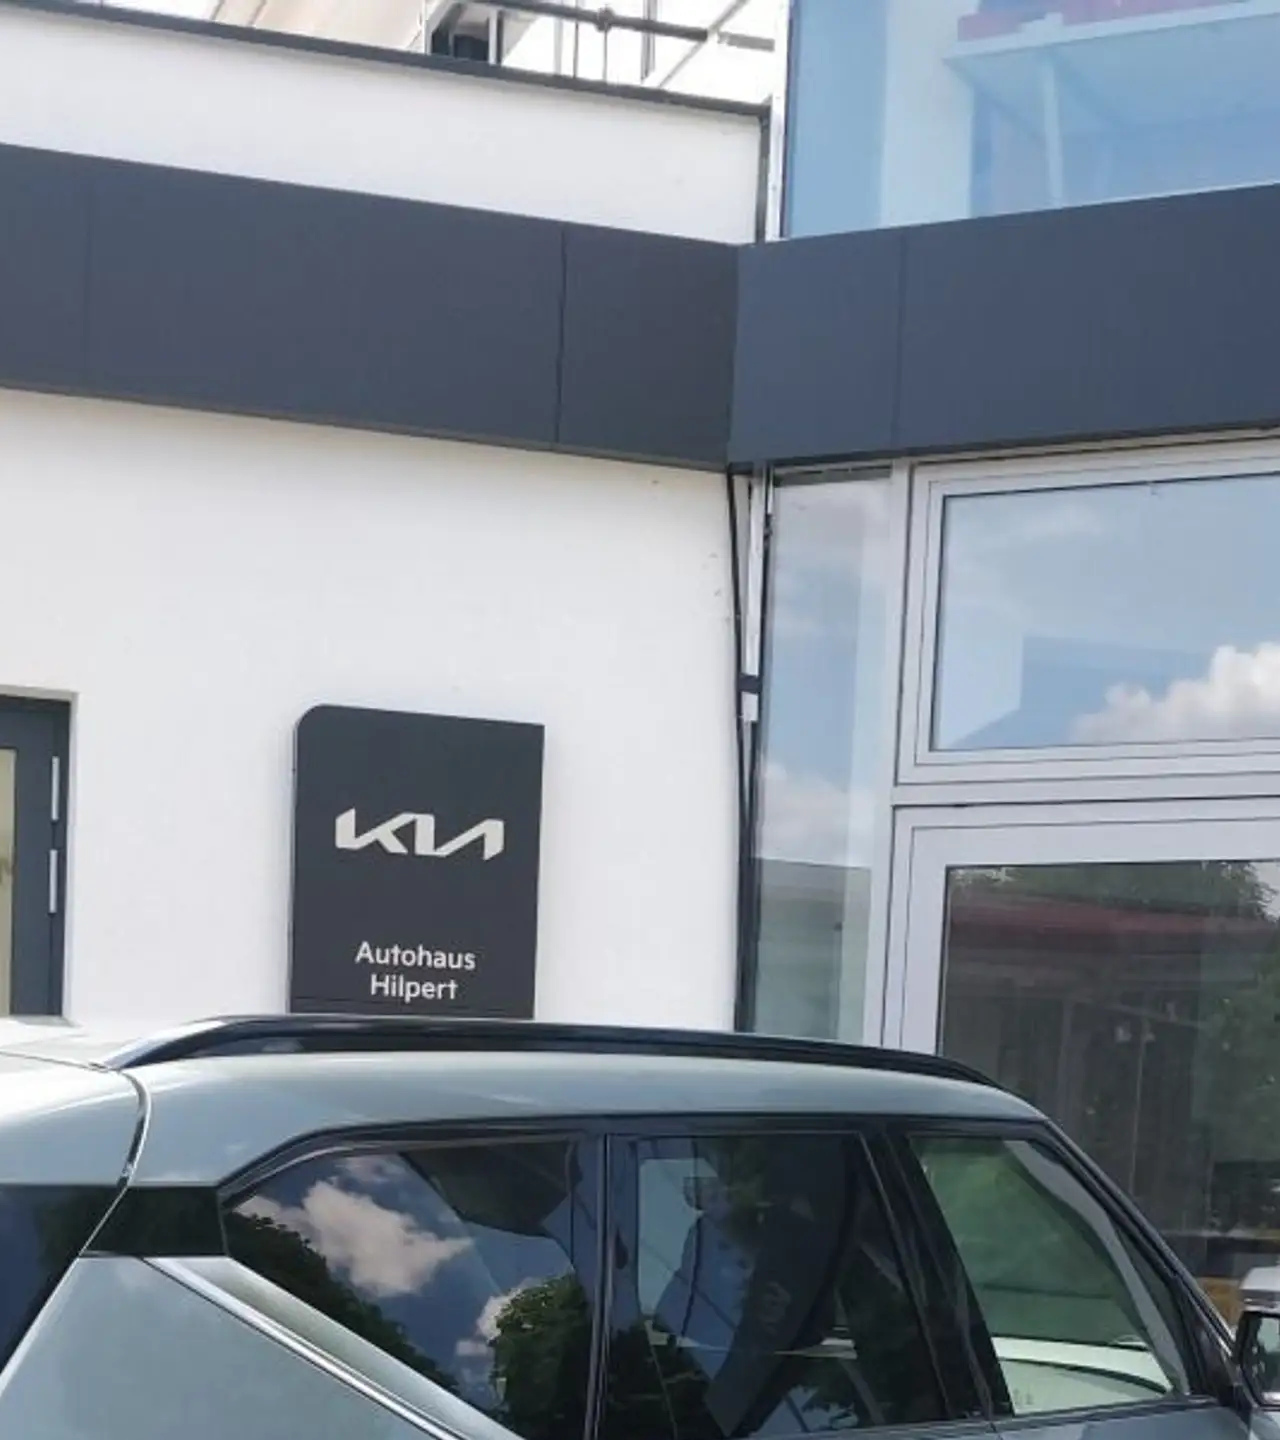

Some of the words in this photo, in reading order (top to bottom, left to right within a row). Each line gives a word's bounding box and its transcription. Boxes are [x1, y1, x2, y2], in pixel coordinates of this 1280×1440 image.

[335, 807, 504, 861] KIA
[355, 941, 476, 970] Autohaus
[371, 974, 459, 1003] Hilpert
